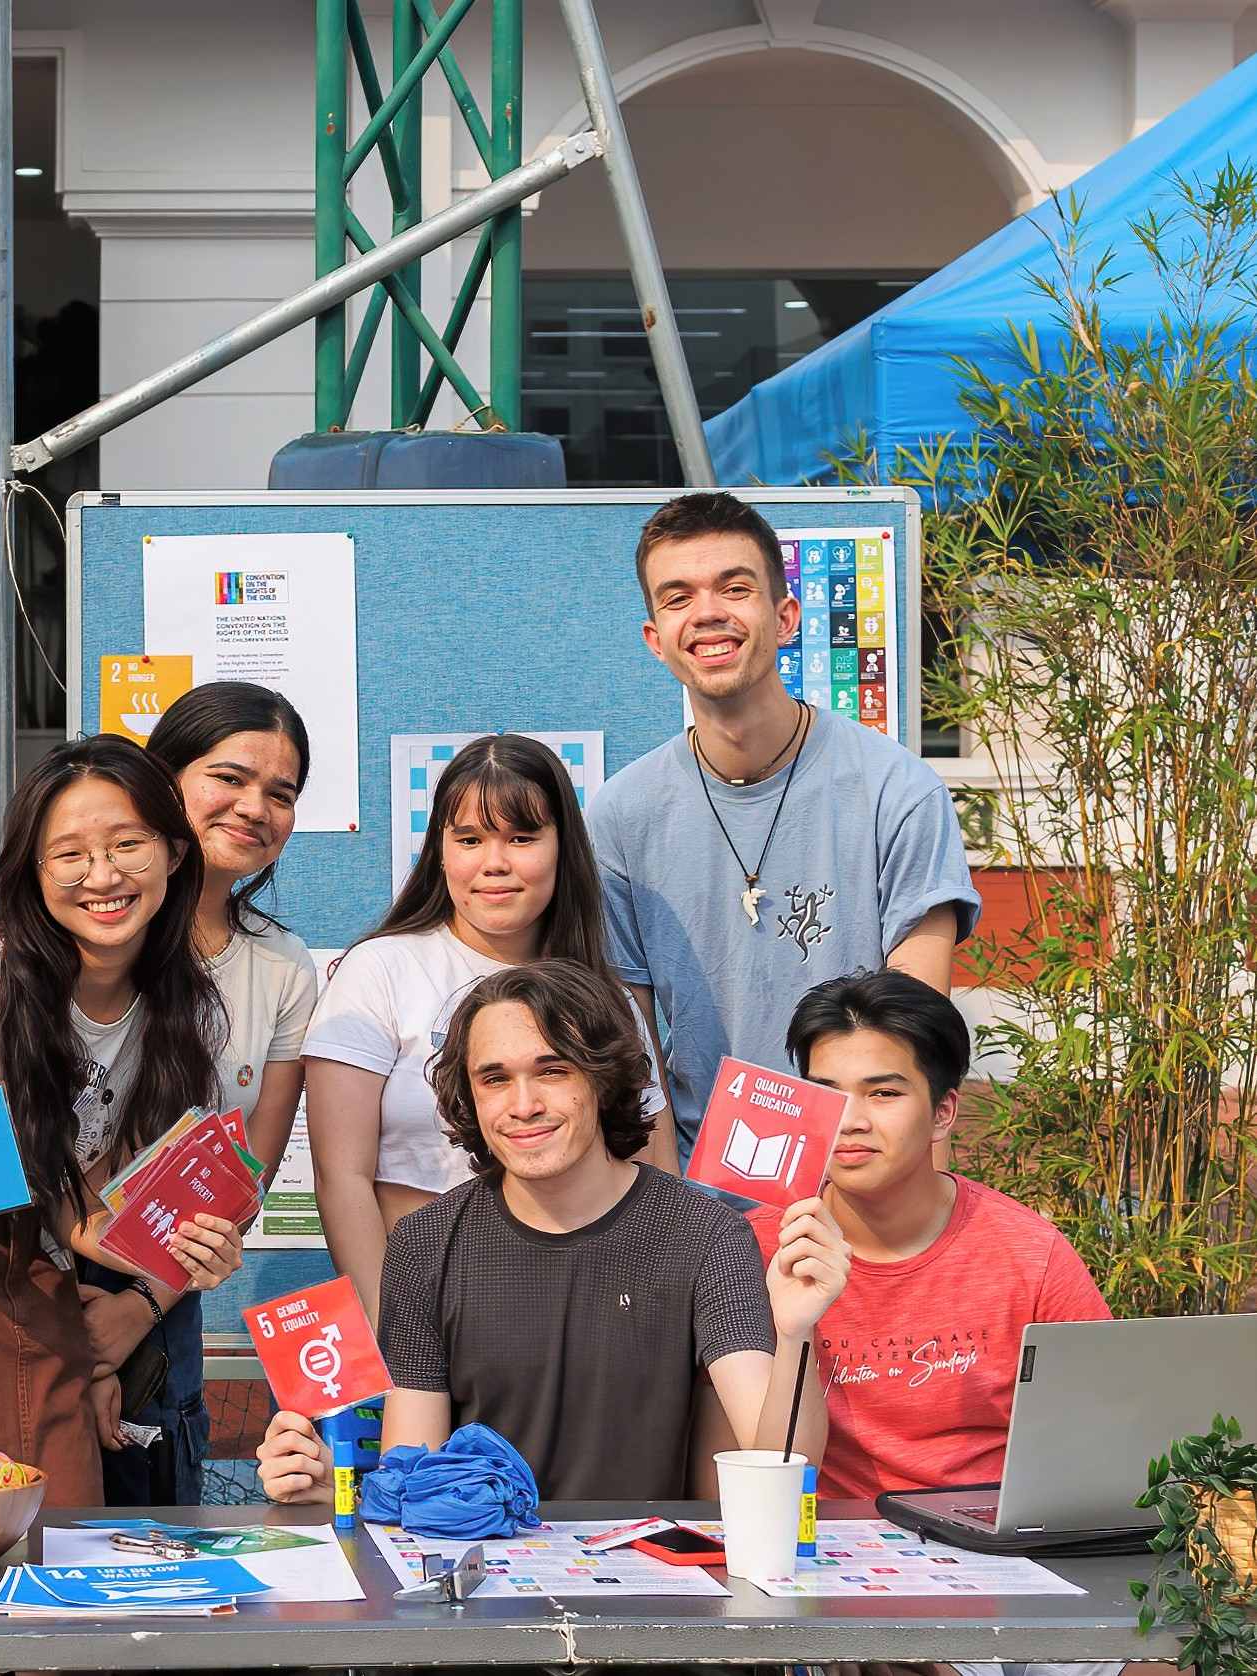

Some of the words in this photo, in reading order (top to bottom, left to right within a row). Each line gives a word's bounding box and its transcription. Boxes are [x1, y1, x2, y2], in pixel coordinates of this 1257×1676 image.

[111, 661, 122, 683] 2
[727, 1072, 747, 1099] 4
[755, 1077, 795, 1099] QUALITY
[749, 1092, 803, 1118] EDUCATION
[179, 1157, 199, 1177] 1
[189, 1177, 216, 1204] POVERTY
[276, 1299, 309, 1319] GENDER
[257, 1311, 276, 1338] 5
[282, 1311, 320, 1333] EQUALITY
[870, 1336, 914, 1348] CAN
[932, 1329, 990, 1344] MAKE
[888, 1367, 904, 1377] on
[909, 1340, 978, 1388] Sundays
[46, 1569, 88, 1580] 14
[130, 1565, 180, 1574] BELOW
